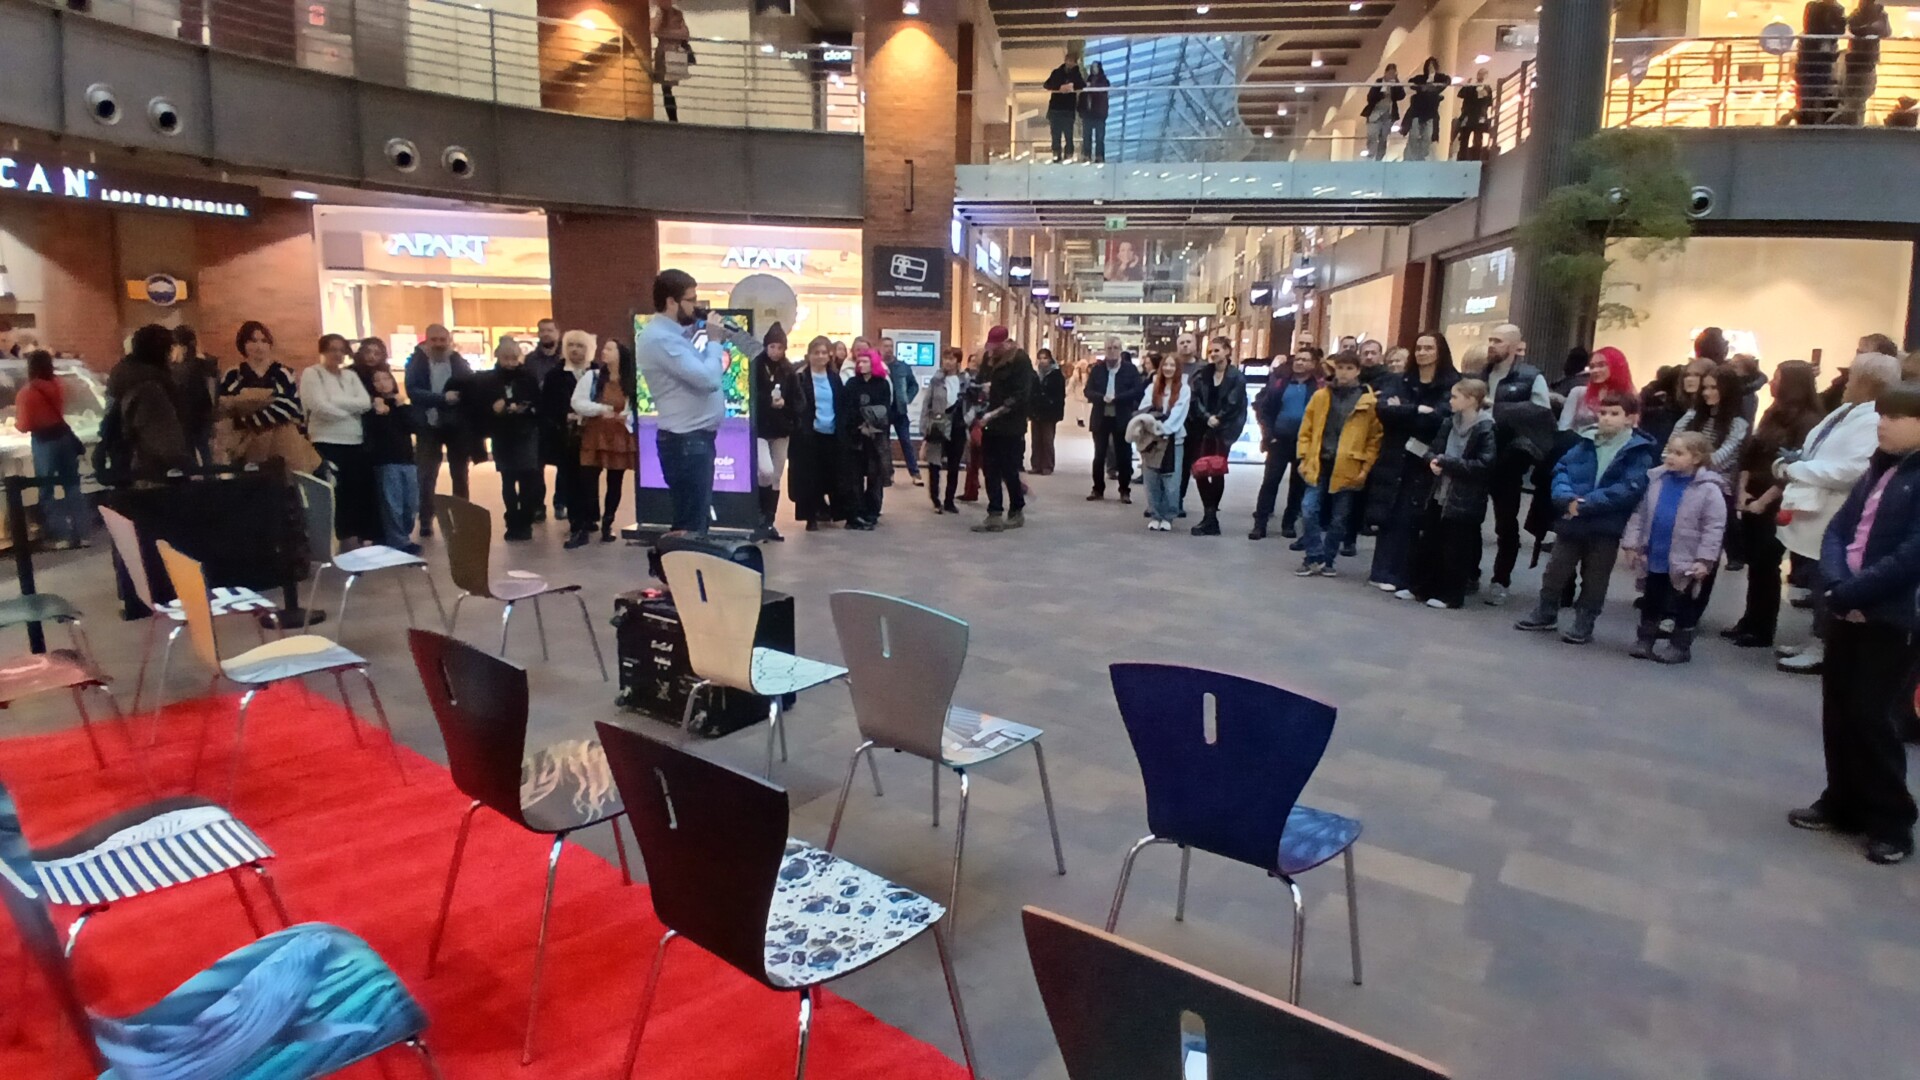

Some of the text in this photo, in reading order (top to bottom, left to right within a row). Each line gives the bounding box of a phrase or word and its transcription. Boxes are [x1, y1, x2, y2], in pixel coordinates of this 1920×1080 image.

[101, 188, 142, 204] LODY
[145, 194, 169, 208] OD
[386, 232, 489, 265] APART
[720, 246, 808, 273] APART
